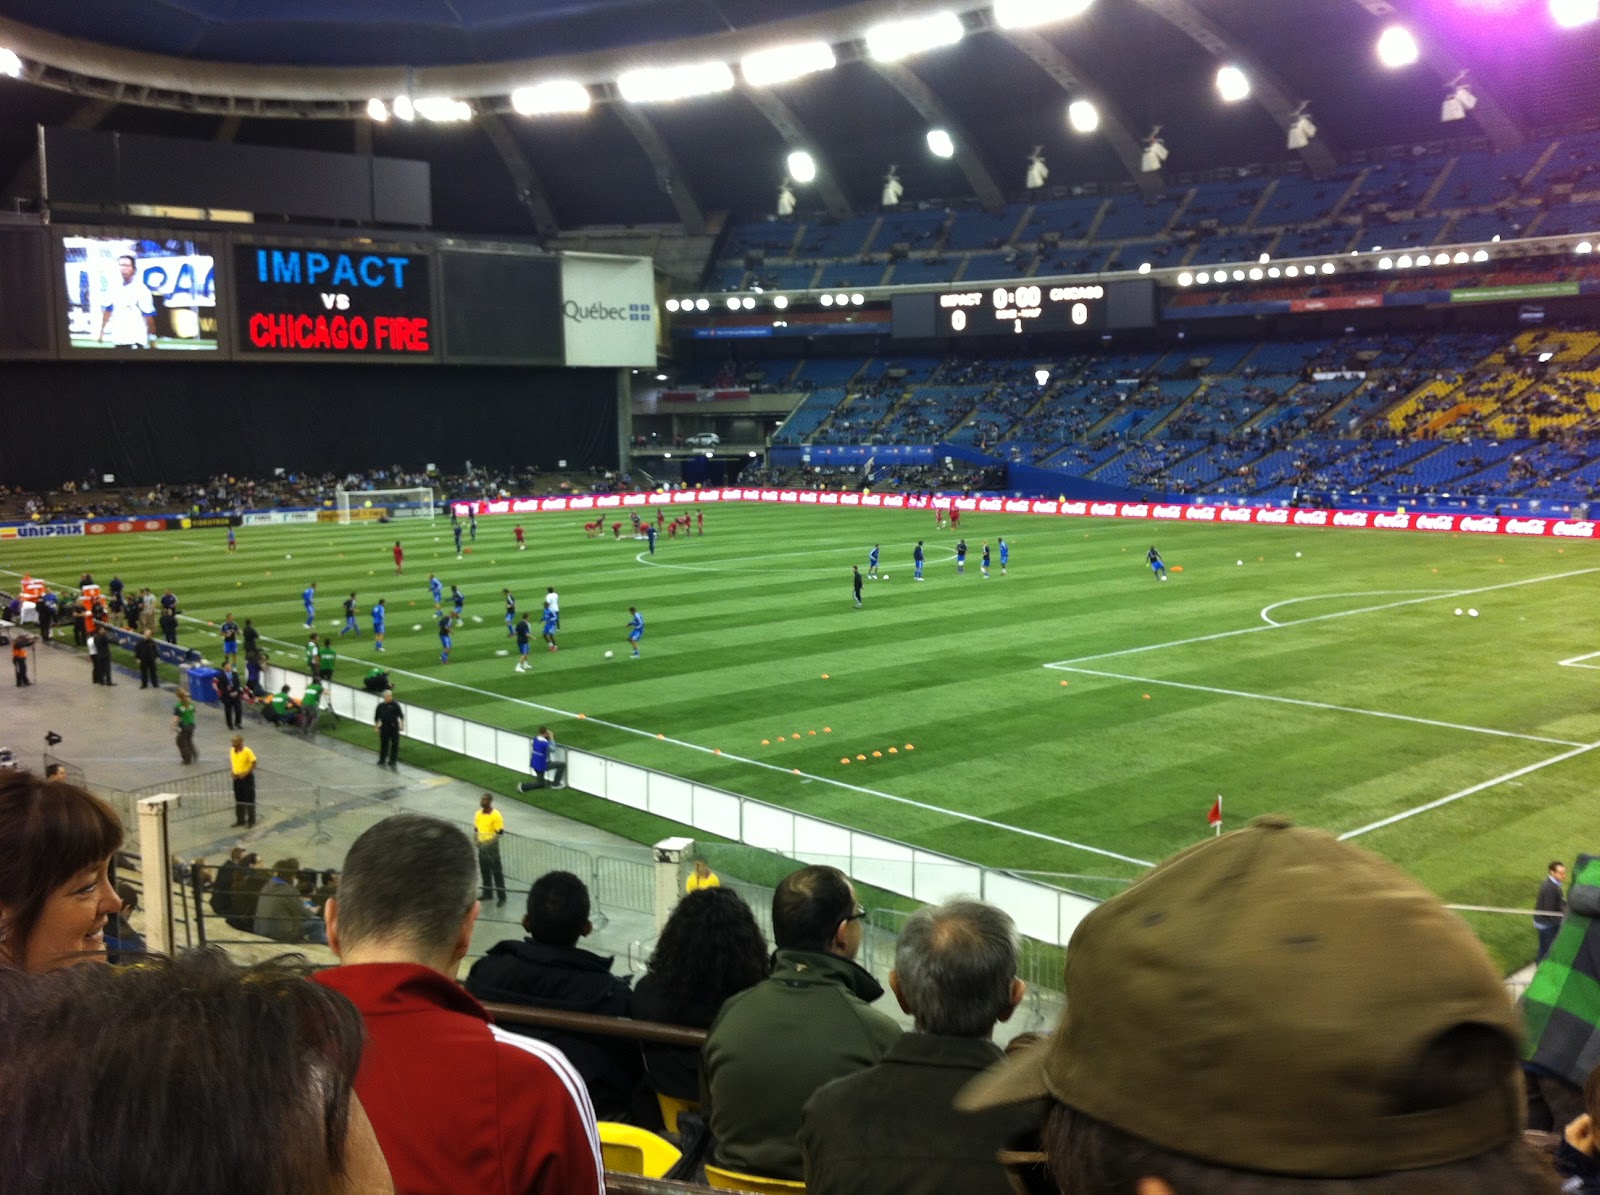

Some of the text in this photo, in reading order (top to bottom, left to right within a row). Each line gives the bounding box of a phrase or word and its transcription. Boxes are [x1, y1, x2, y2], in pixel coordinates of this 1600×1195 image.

[257, 250, 410, 289] IMPACT
[993, 285, 1041, 309] 0:00
[564, 299, 627, 323] Québec
[952, 309, 966, 331] 0
[1072, 302, 1087, 325] 0
[250, 312, 368, 349] CHICAGO
[374, 315, 430, 351] FIRE
